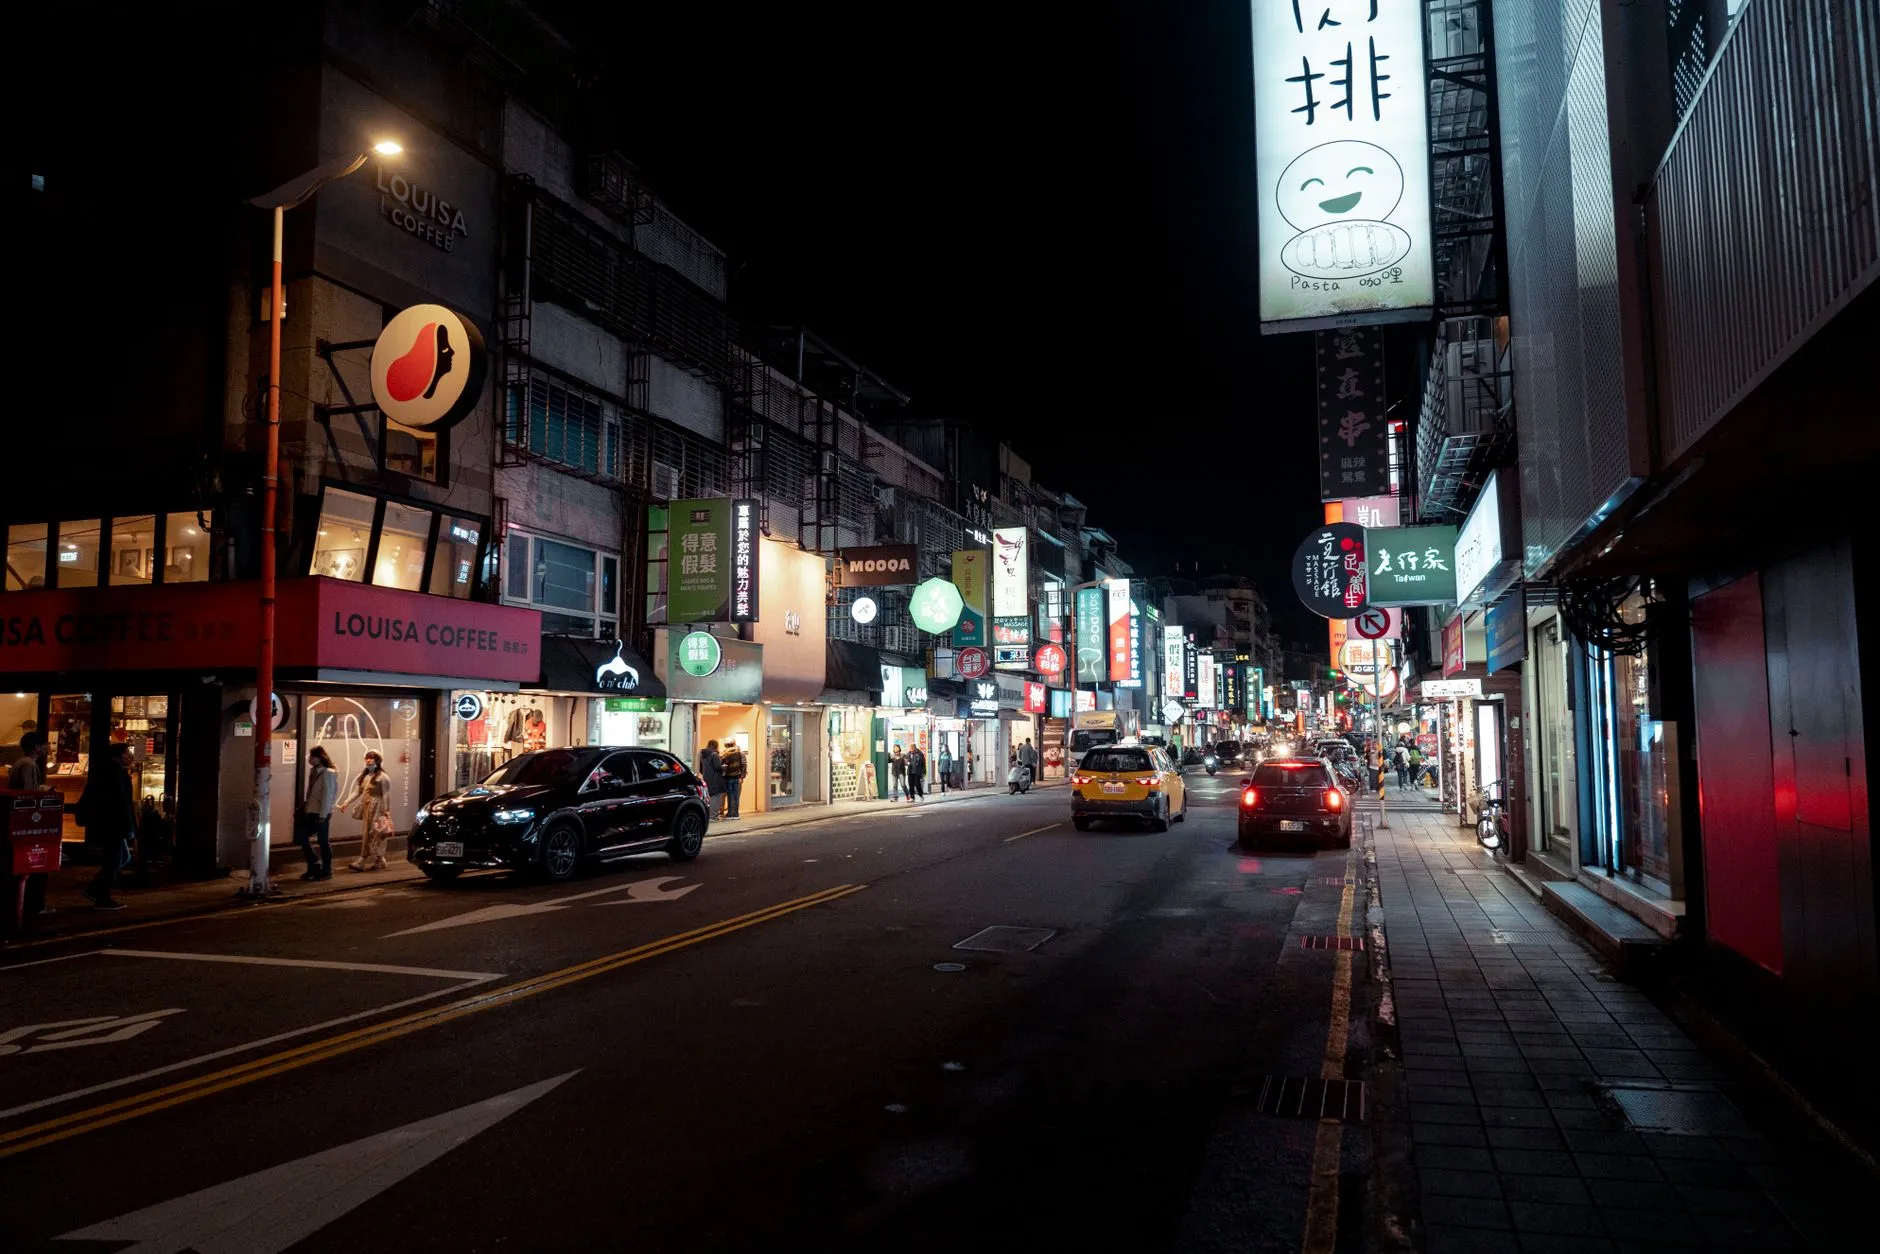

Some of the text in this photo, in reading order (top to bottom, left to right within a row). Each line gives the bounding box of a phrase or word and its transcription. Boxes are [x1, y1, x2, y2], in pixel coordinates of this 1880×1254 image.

[376, 164, 468, 237] LOUISA
[392, 208, 455, 252] COFFEE
[1291, 275, 1340, 291] Pasta
[681, 532, 717, 553] 得意
[681, 554, 717, 575] 假髮
[850, 558, 910, 573] MOOQA
[1374, 546, 1449, 575] 老行家
[334, 611, 418, 643] LOUISA
[425, 623, 498, 651] COFFEE
[688, 636, 709, 648] 得意
